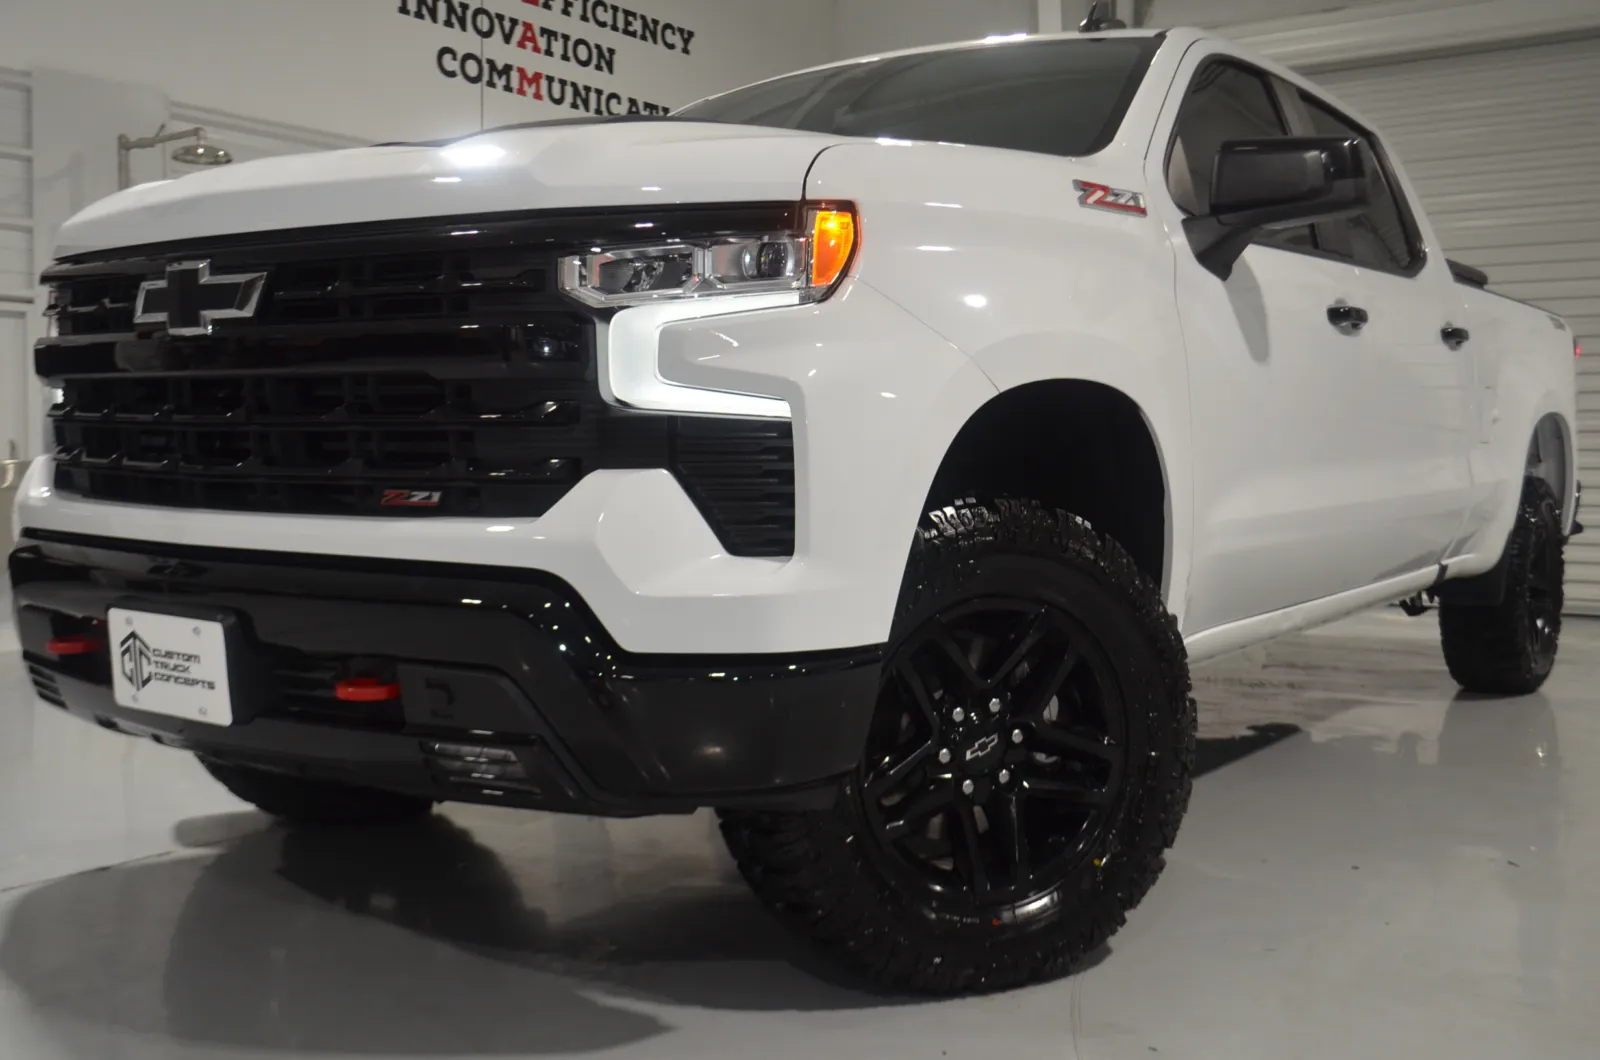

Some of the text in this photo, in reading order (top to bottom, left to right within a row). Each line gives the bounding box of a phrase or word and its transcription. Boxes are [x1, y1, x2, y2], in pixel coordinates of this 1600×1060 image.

[521, 0, 695, 55] FICIENCY
[152, 648, 201, 664] CUSTOM
[153, 660, 191, 674] TRUCK
[154, 672, 216, 691] CONCEPTS
